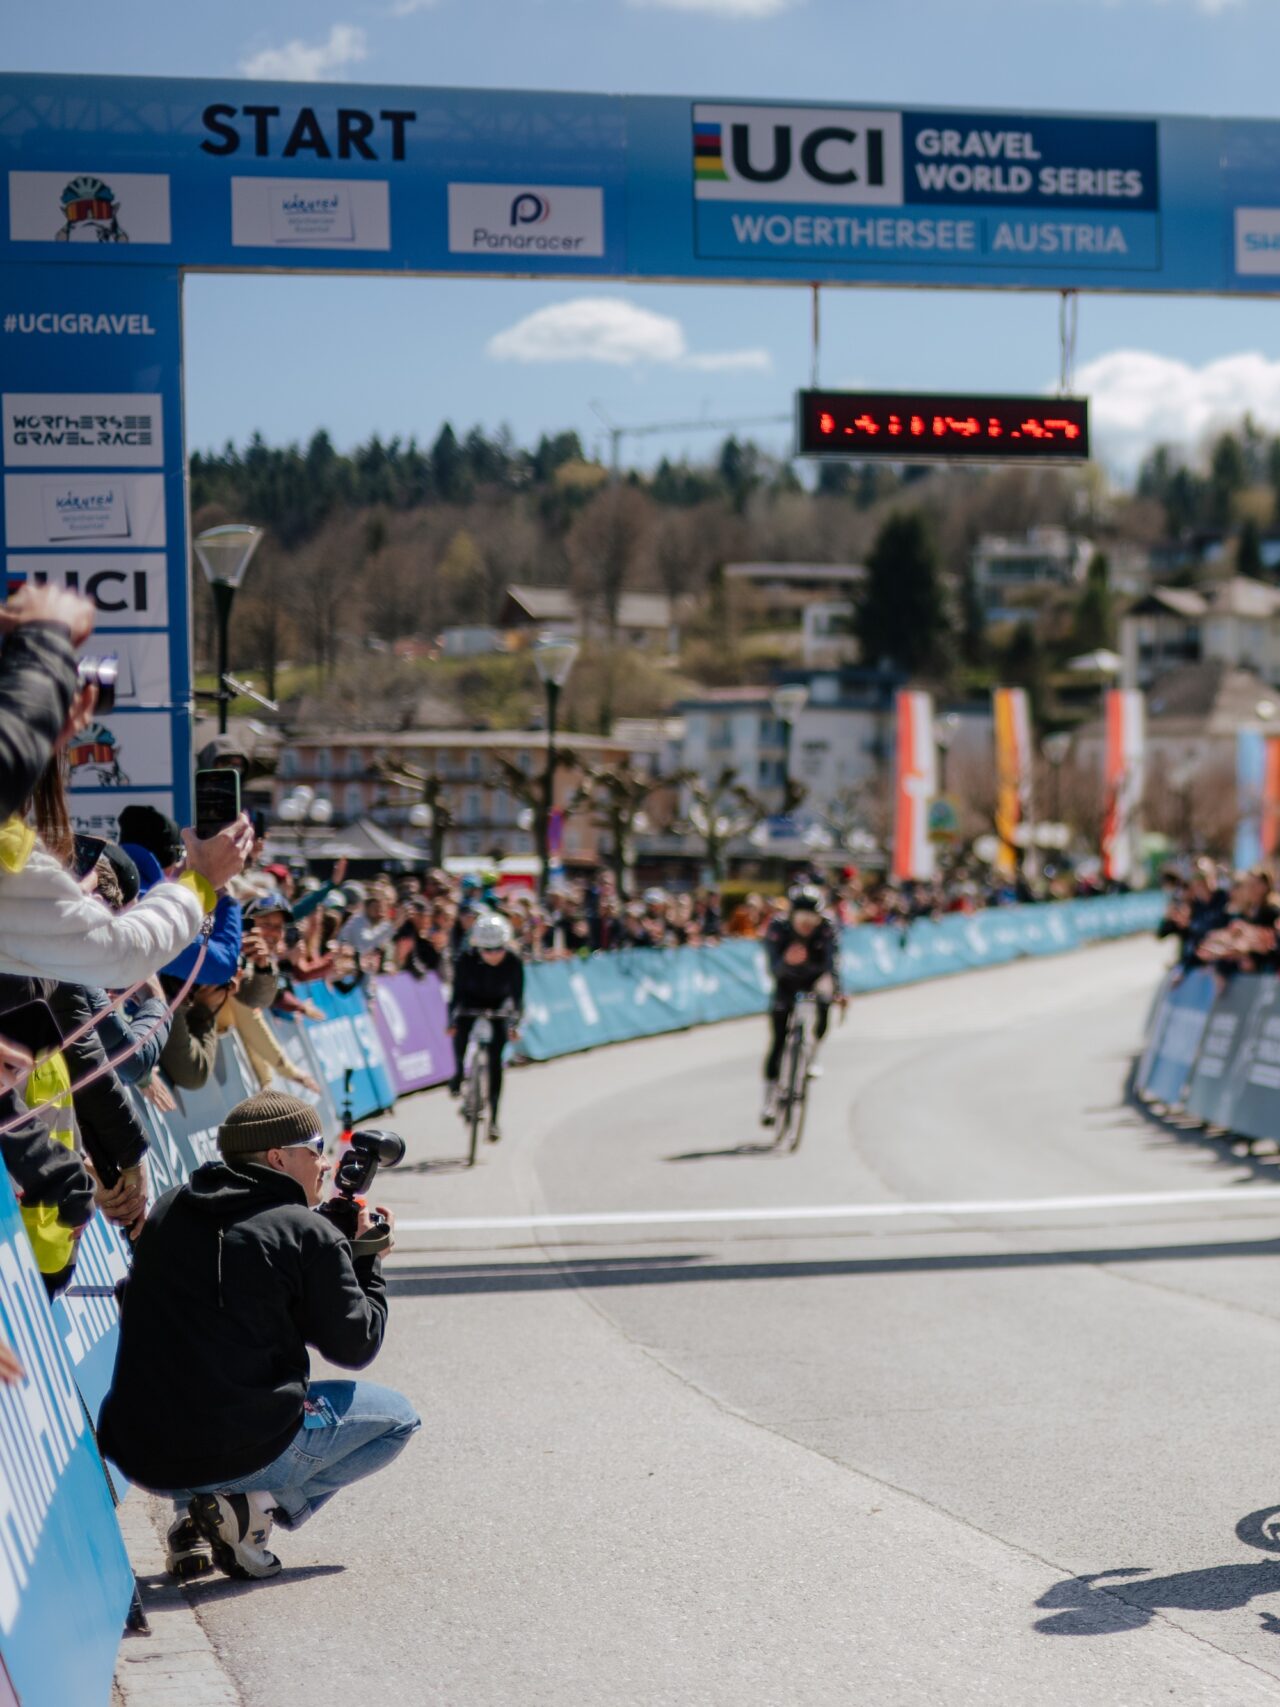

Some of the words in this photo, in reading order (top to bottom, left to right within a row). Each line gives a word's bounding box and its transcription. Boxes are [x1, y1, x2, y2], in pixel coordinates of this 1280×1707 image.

[200, 103, 417, 161] START
[915, 128, 1041, 160] GRAVEL
[731, 123, 884, 187] UCI
[915, 163, 1033, 193] WORLD
[1038, 167, 1144, 197] SERIES
[473, 228, 584, 250] Panaracer
[732, 213, 976, 250] WOERTHERSEE
[992, 223, 1129, 254] AUSTRIA
[3, 313, 155, 335] #UCIGRAVEL
[13, 431, 95, 446] GRAVEL
[97, 431, 152, 446] RACE
